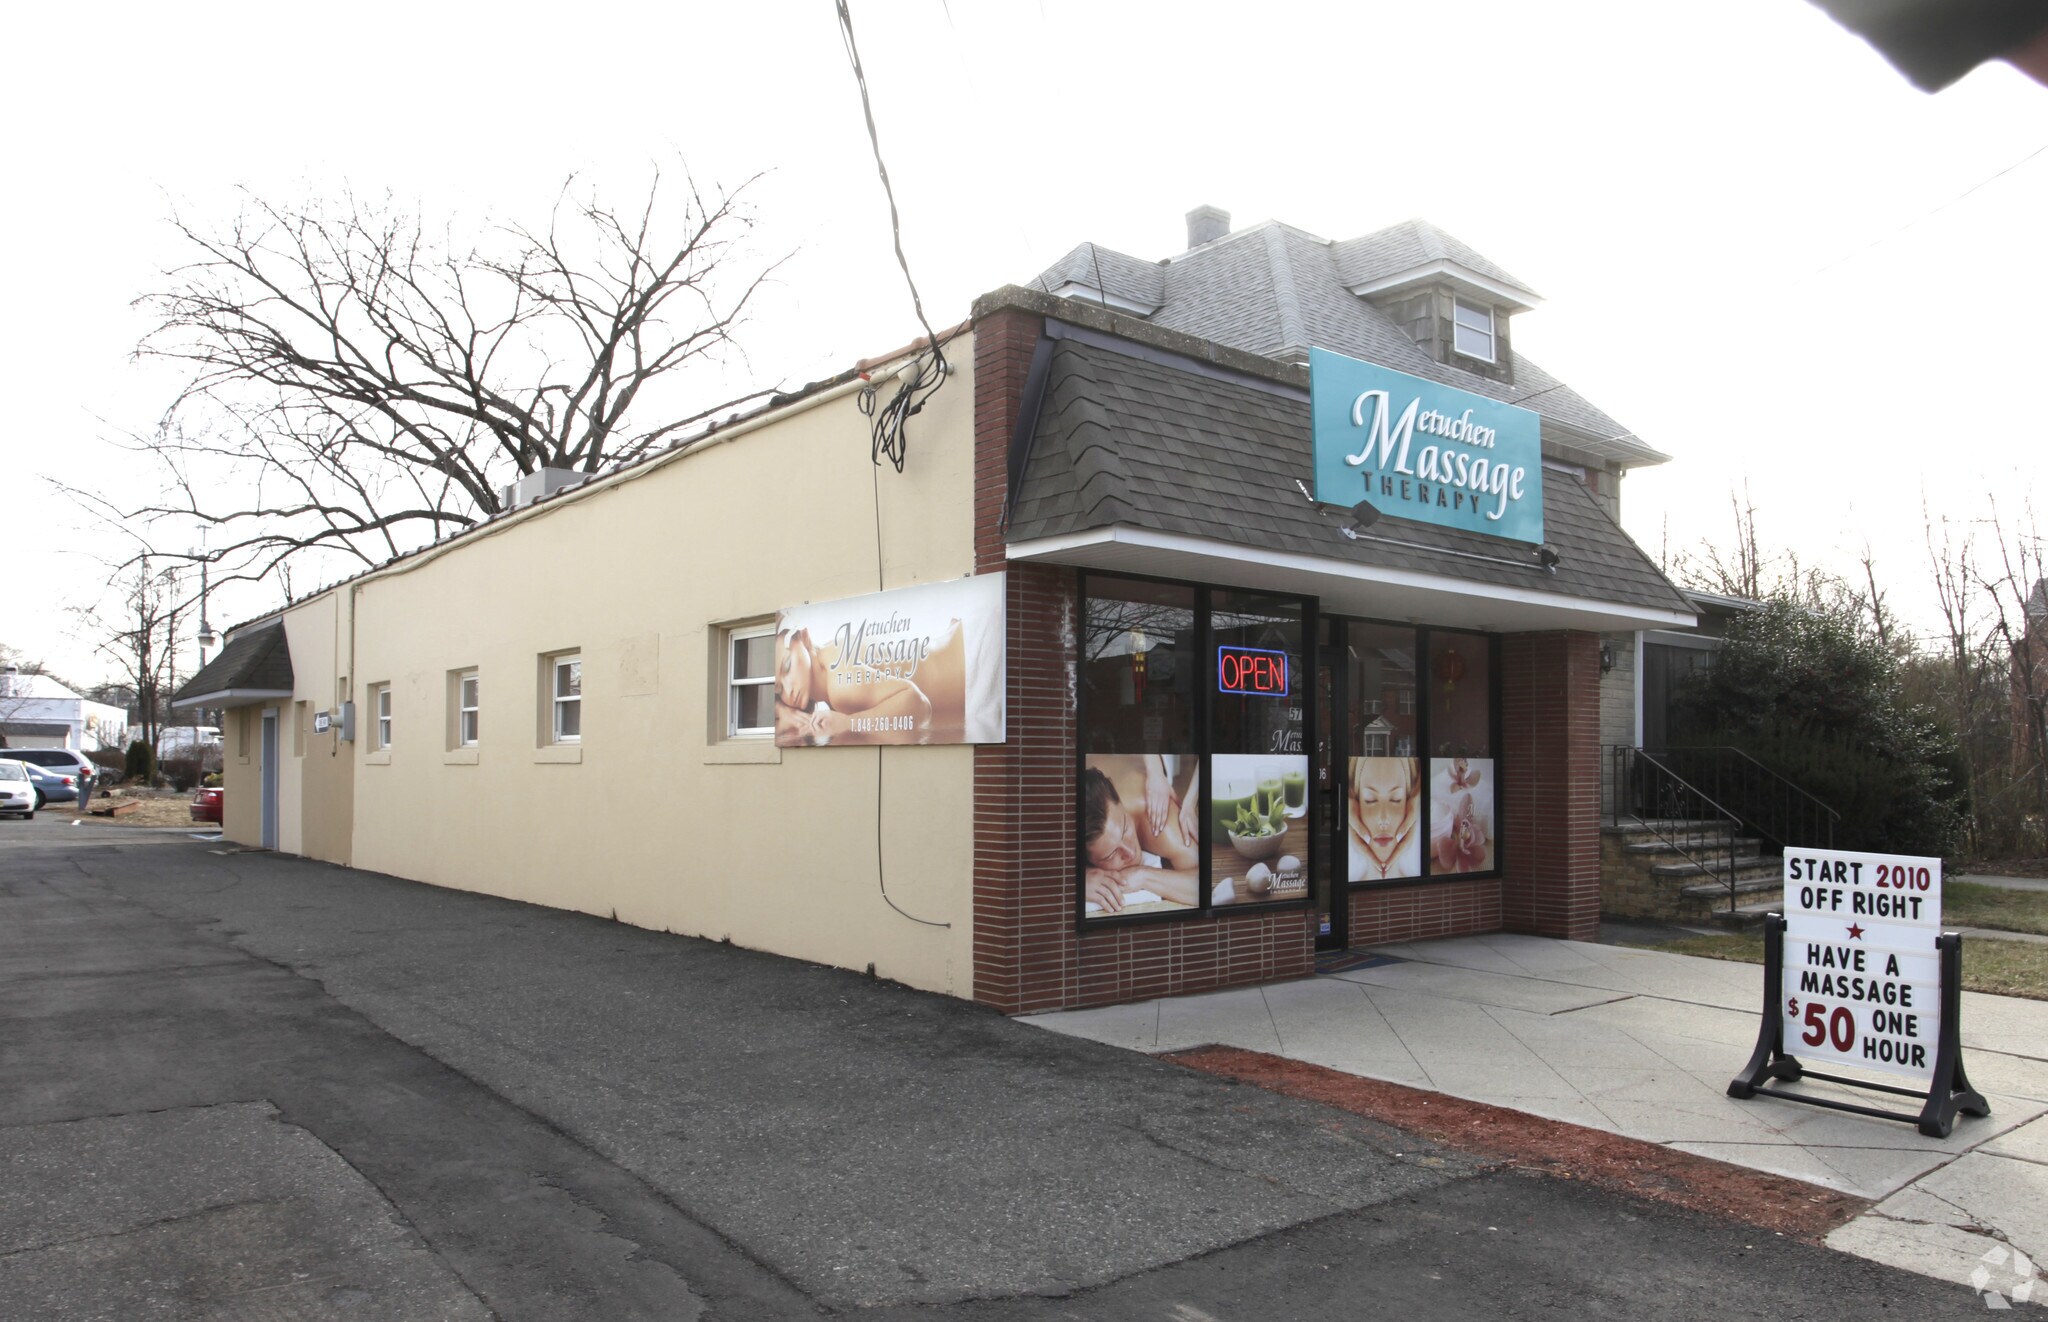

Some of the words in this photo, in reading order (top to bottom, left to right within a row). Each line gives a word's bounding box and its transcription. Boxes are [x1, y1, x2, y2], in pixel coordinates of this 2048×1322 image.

[1345, 389, 1495, 474] Metuchen
[1345, 389, 1525, 520] Massage
[1362, 471, 1480, 514] THERAPY
[830, 610, 911, 669] Metuchen
[830, 618, 930, 678] Massage
[837, 668, 901, 685] THERAPY
[1221, 654, 1284, 691] OPEN
[1789, 857, 1863, 885] START
[1876, 864, 1931, 891] 2010
[1801, 886, 1843, 912] OFF
[1853, 891, 1923, 920] RIGHT
[1807, 943, 1866, 972] HAVE
[1885, 954, 1900, 977] A
[1800, 970, 1913, 1007] MASSAGE
[1788, 997, 1855, 1052] $50
[1873, 1009, 1918, 1037] ONE
[1863, 1036, 1926, 1068] HOUR
